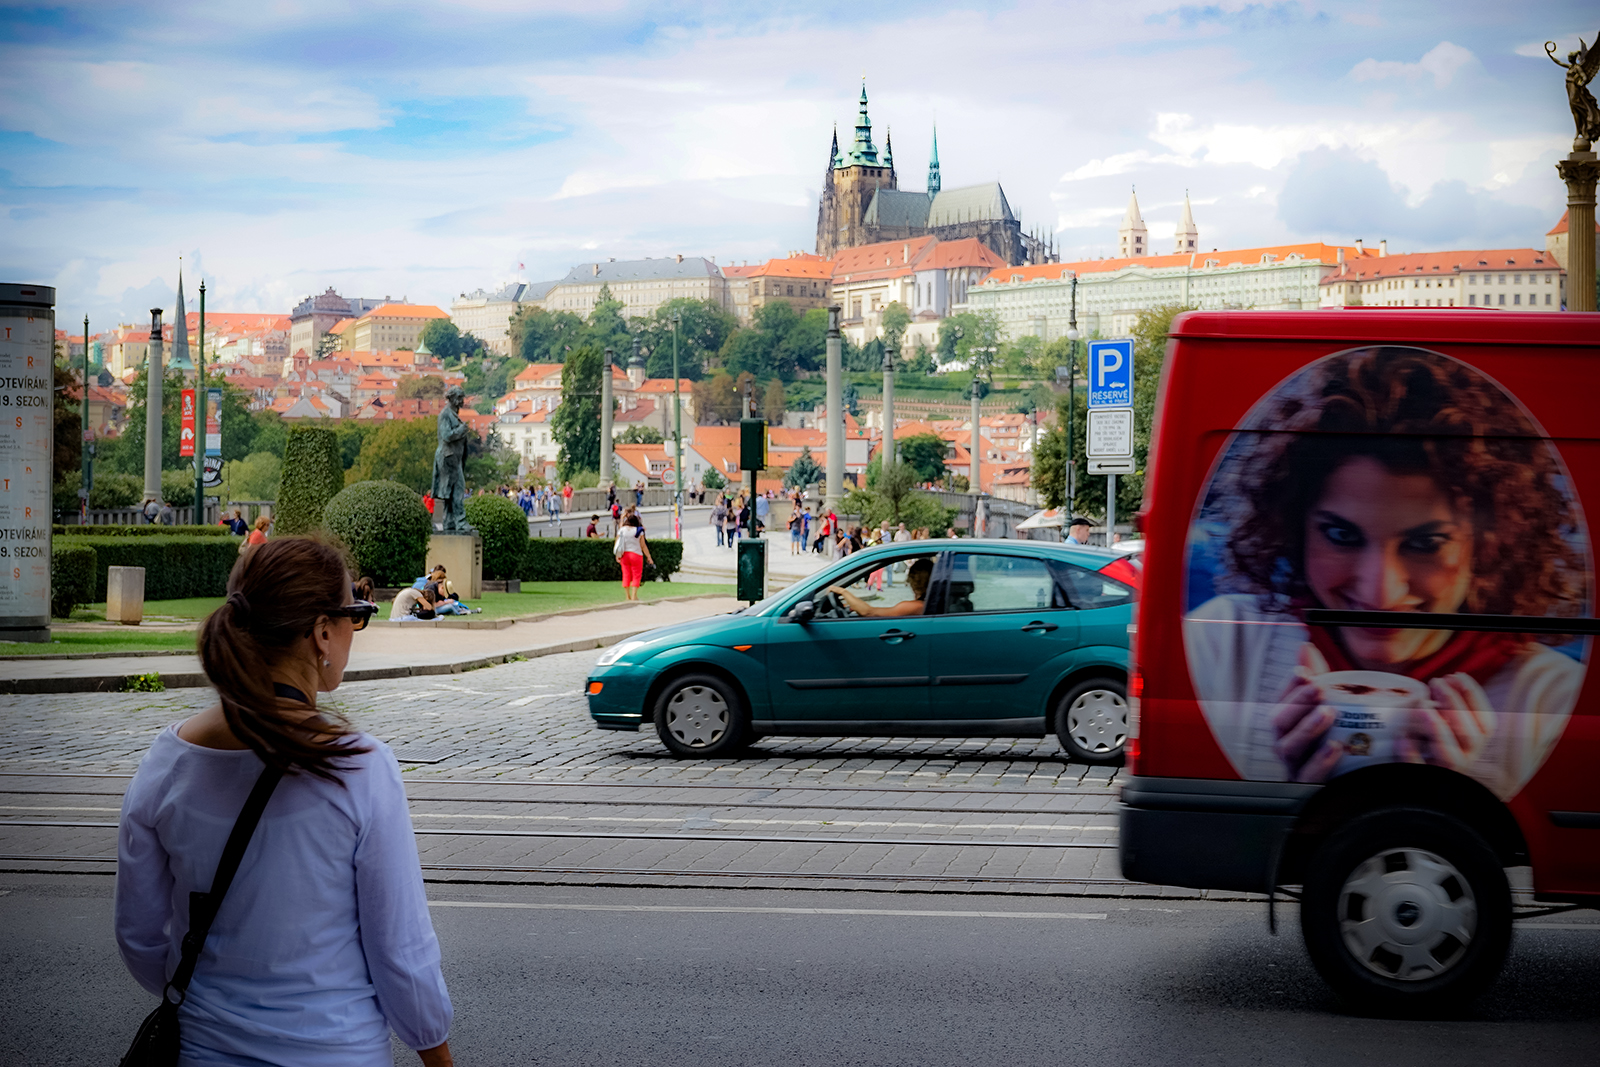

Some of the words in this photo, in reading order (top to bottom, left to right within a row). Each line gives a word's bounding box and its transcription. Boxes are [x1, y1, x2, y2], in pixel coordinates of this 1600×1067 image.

[5, 327, 12, 339] T
[27, 356, 34, 367] R
[1098, 349, 1122, 387] P
[15, 416, 23, 428] S
[3, 479, 11, 490] T
[25, 507, 32, 518] R
[13, 567, 21, 579] S
